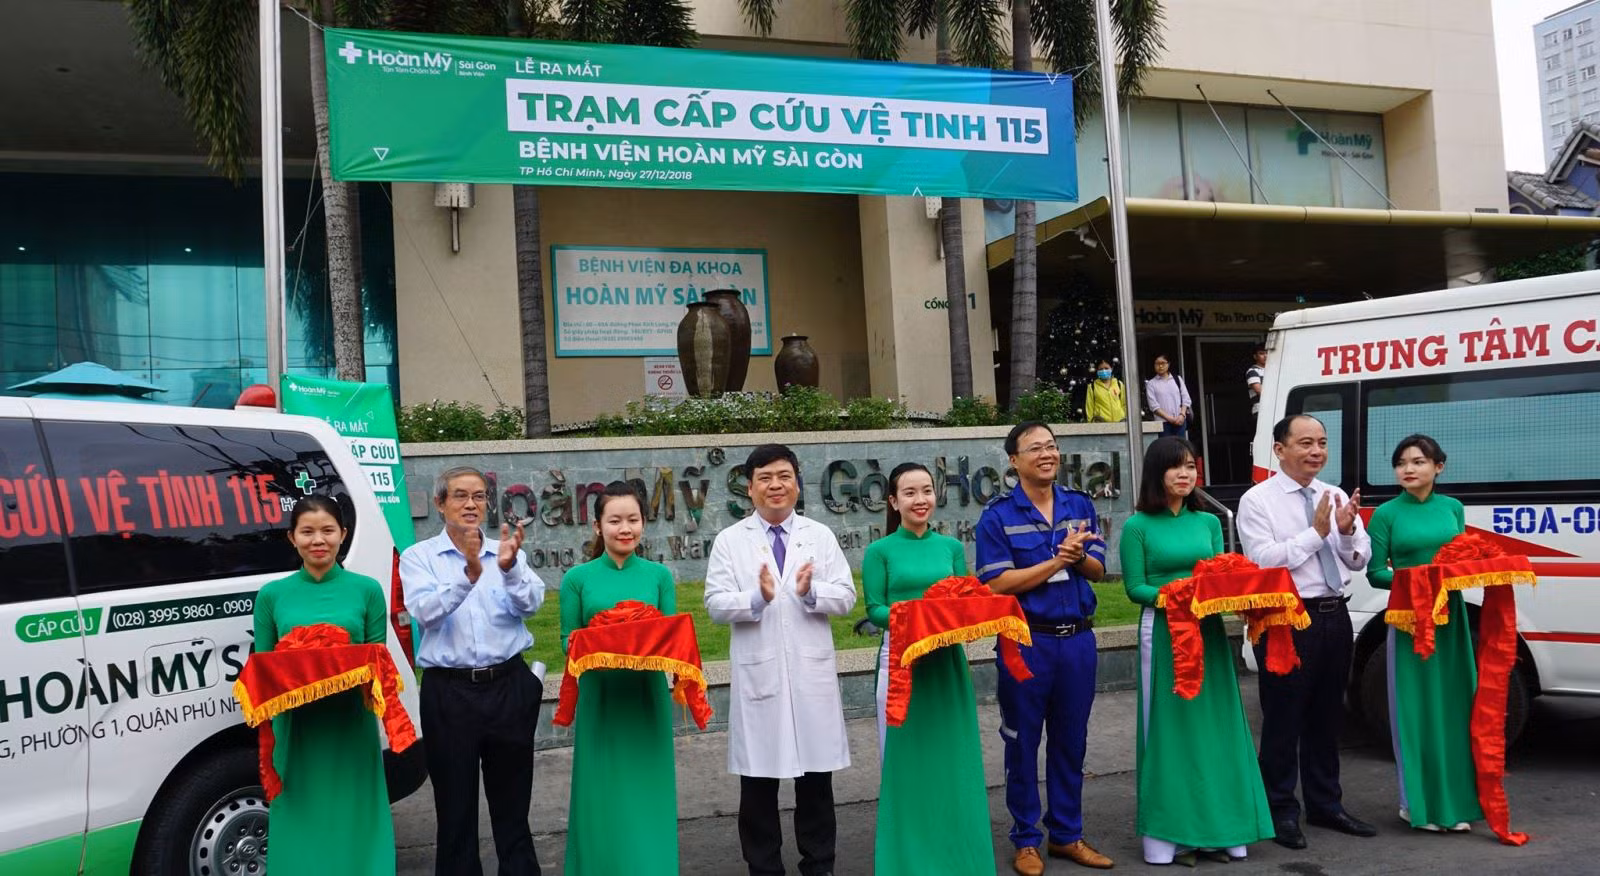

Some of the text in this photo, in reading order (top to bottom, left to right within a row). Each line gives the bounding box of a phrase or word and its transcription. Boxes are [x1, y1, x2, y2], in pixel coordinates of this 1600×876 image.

[367, 49, 453, 72] Hoàn Mỹ
[458, 60, 497, 71] Sài Gòn
[514, 56, 603, 78] LỄ RA MẮT
[517, 90, 1043, 145] TRẠM CẤP CỨU VỆ TINH 115
[518, 136, 864, 170] BỆNH VIỆN HOÀN MỸ SÀI GÒN
[519, 166, 693, 181] TP Hồ Chí Minh, Ngày 27/12/2018
[579, 256, 742, 277] BỆNH VIỆN ĐA KHOA
[565, 283, 630, 306] HOÀN
[636, 284, 668, 306] MỸ
[967, 292, 977, 310] 1
[1317, 317, 1600, 377] TRUNG TÂM C
[333, 419, 369, 433] RA MẮT
[370, 441, 396, 460] CỨU
[370, 471, 390, 487] 115
[0, 463, 75, 539] CỨU
[80, 469, 137, 539] VỆ
[227, 472, 283, 525] 115
[1492, 506, 1600, 535] 50A-0
[25, 612, 94, 638] CẤP CỨU
[112, 609, 146, 629] (028)
[149, 607, 180, 622] 3995
[182, 603, 214, 620] 9860
[223, 598, 253, 615] 0909
[0, 657, 140, 724] HOÀN
[151, 639, 214, 695] MỸ
[21, 720, 106, 756] PHƯỜNG
[111, 717, 124, 738] 1,
[126, 704, 179, 733] QUẬN
[182, 697, 216, 723] PHÚ
